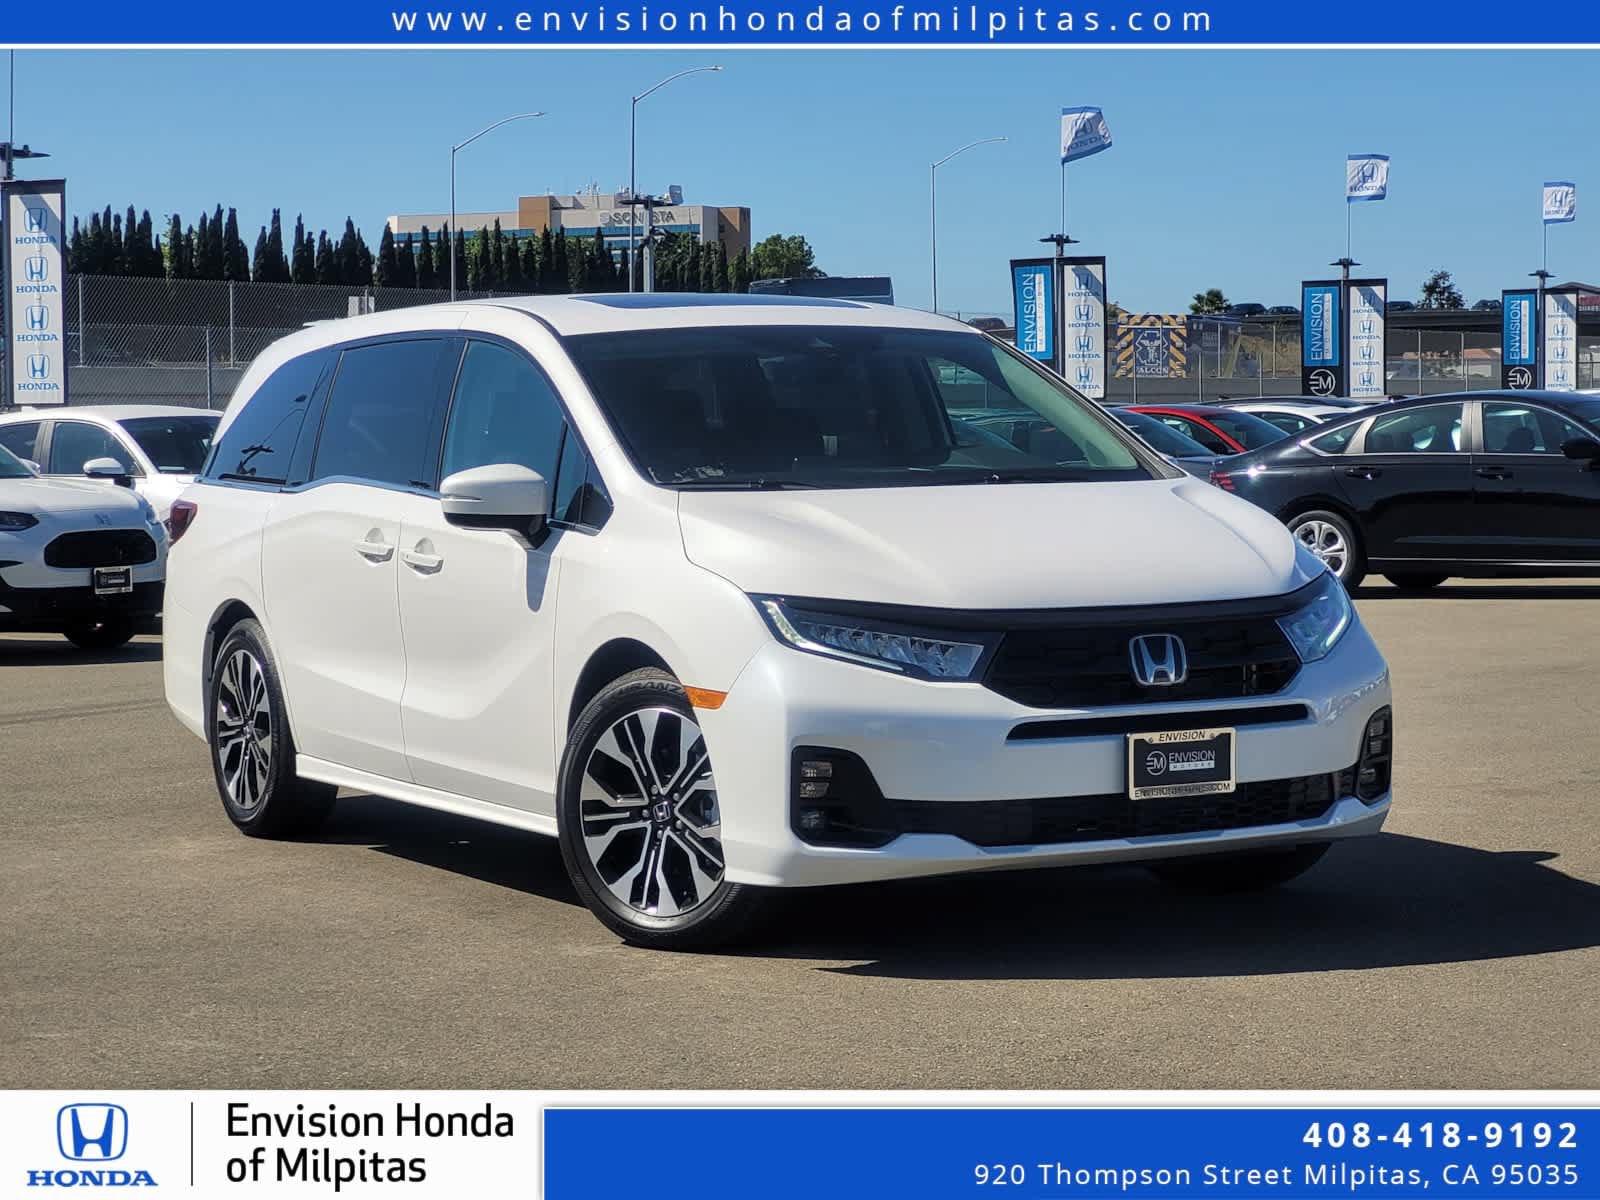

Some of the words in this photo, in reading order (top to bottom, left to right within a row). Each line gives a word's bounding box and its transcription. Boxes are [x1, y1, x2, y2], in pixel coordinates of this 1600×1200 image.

[15, 236, 57, 244] HONDA
[16, 285, 57, 293] HONDA
[1022, 273, 1036, 353] ENVISION
[1311, 293, 1323, 360] ENVISION
[1509, 300, 1521, 360] ENVISION
[17, 334, 58, 342] HONDA
[18, 383, 59, 391] HONDA
[1159, 731, 1206, 742] ENVISION
[1169, 750, 1215, 763] ENVISION
